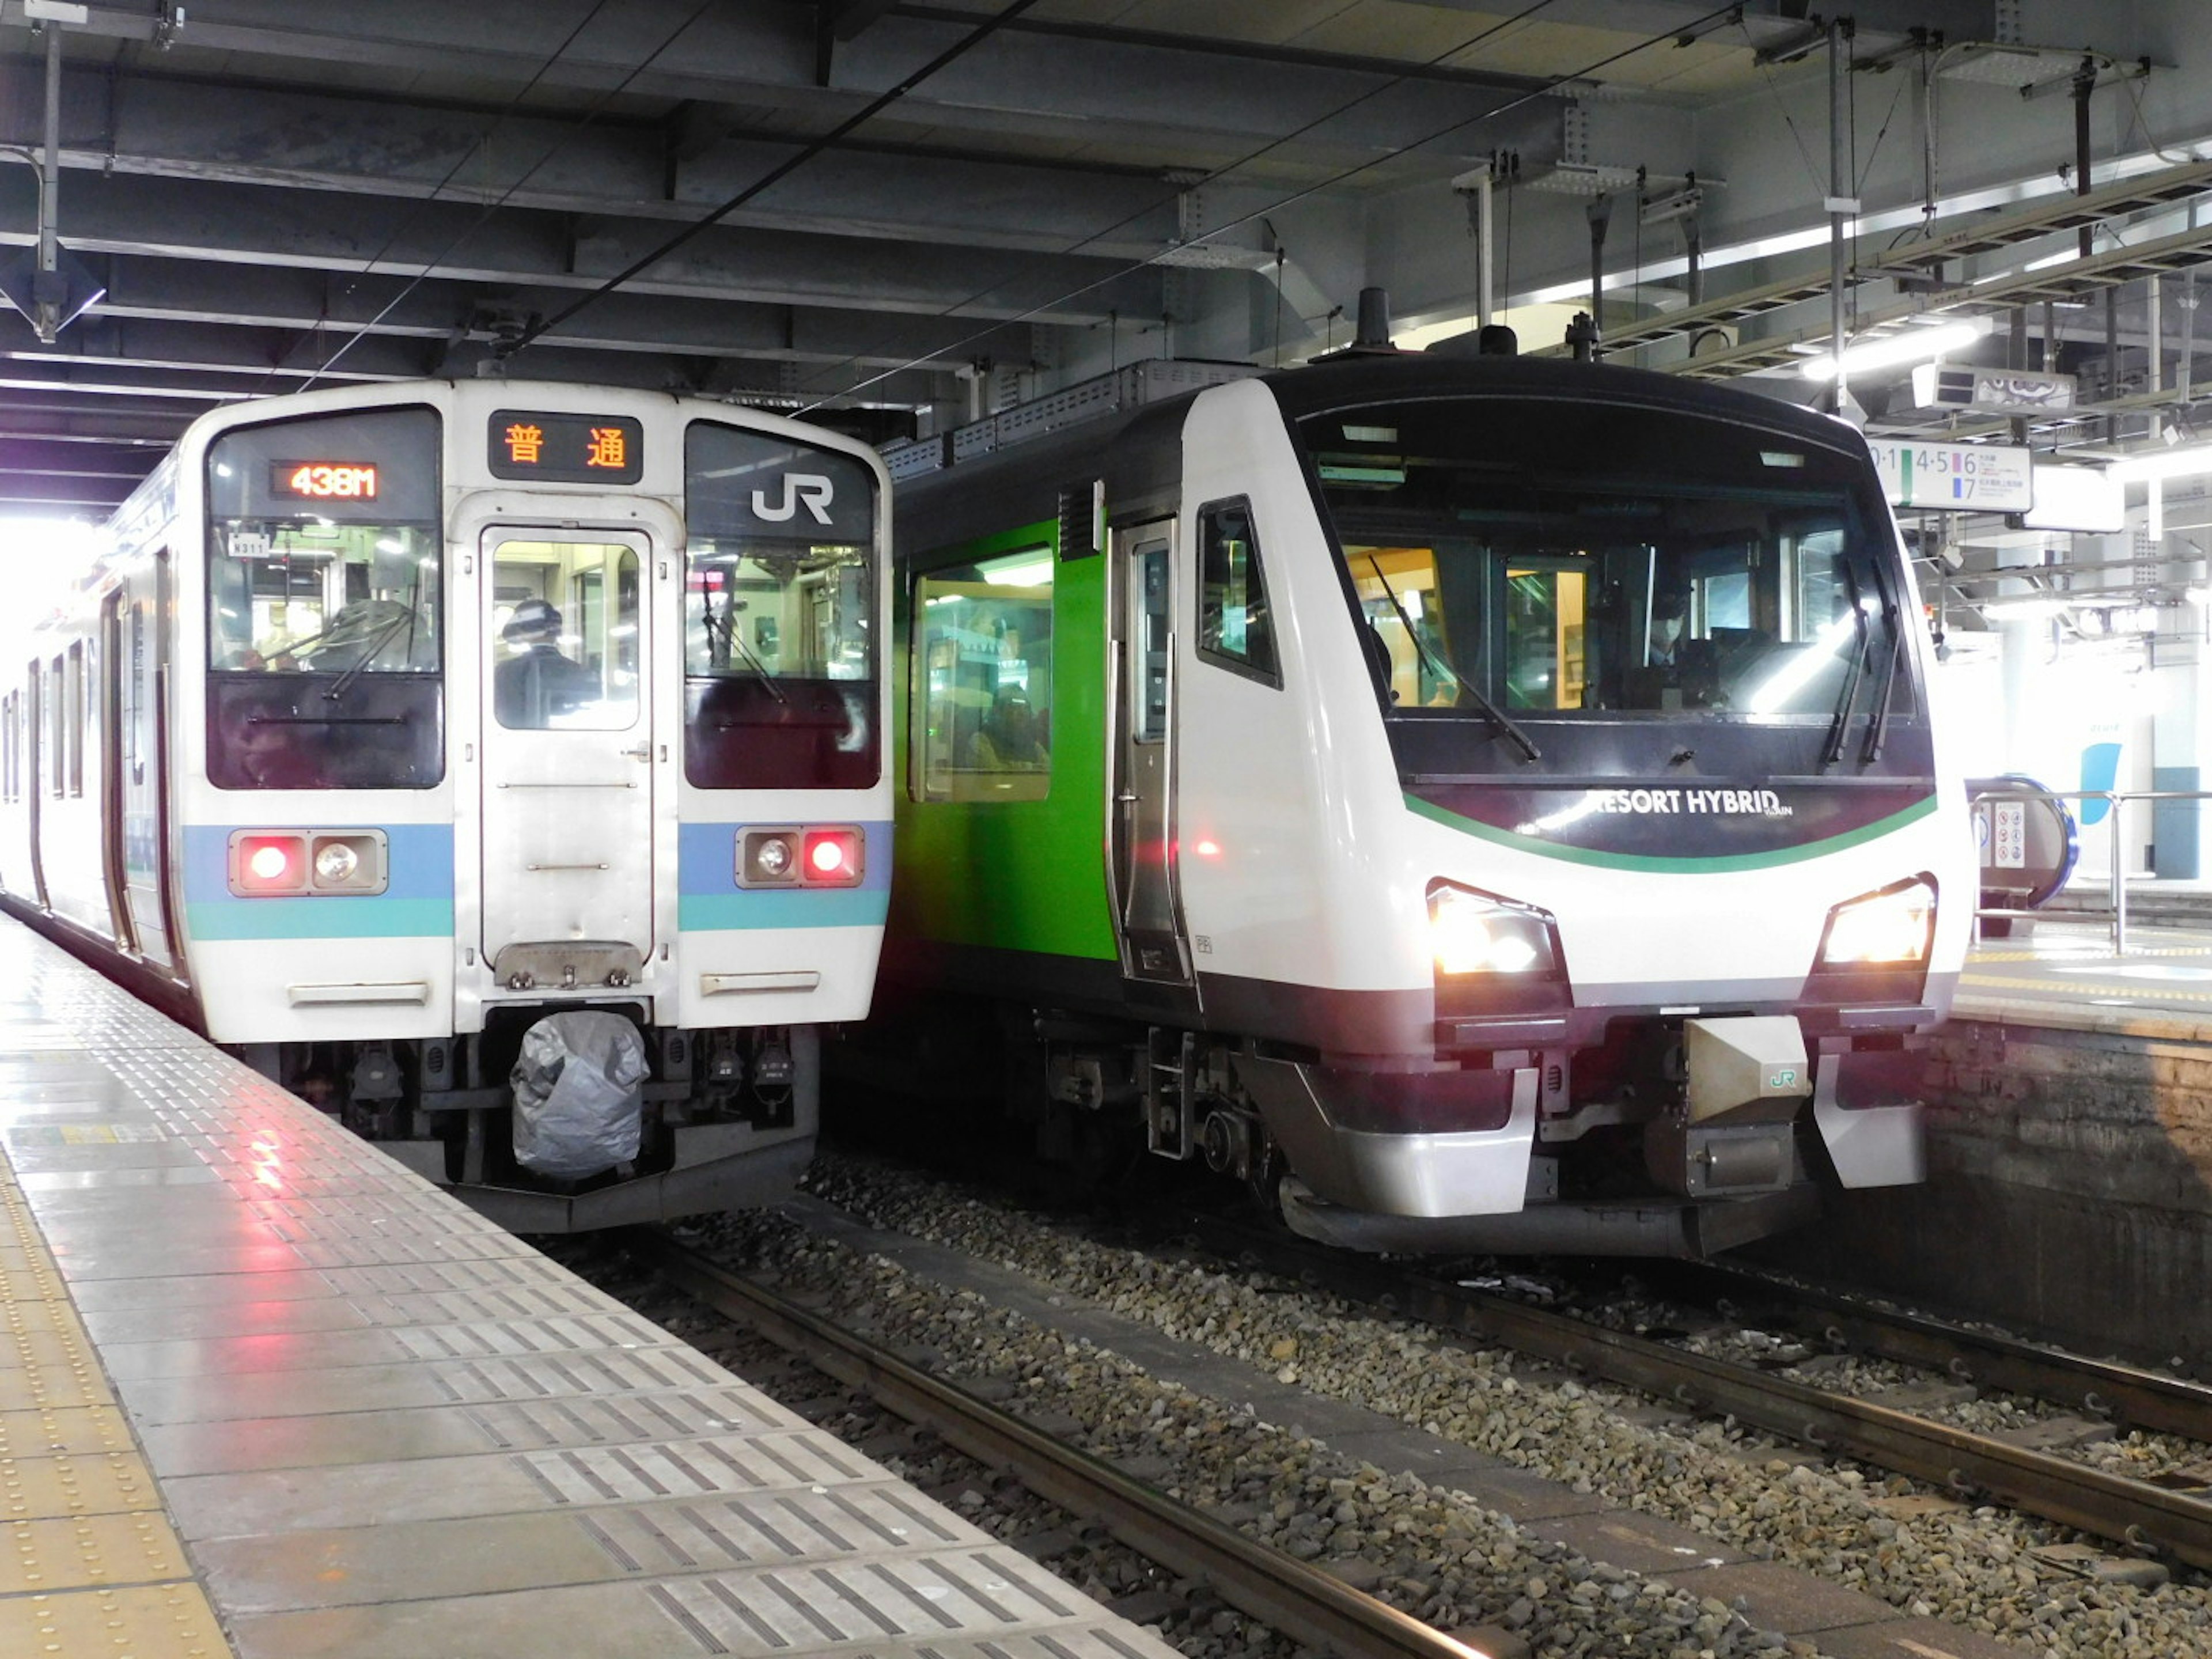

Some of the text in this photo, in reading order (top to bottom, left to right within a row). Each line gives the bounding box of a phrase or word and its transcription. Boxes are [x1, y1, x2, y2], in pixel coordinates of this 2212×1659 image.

[505, 423, 625, 468] 普通
[1964, 453, 1976, 474] 6
[291, 467, 374, 497] 438M
[1965, 479, 1976, 499] 7
[752, 472, 834, 525] JR
[1686, 790, 1779, 814] HYBRID
[1771, 1070, 1794, 1087] JR
